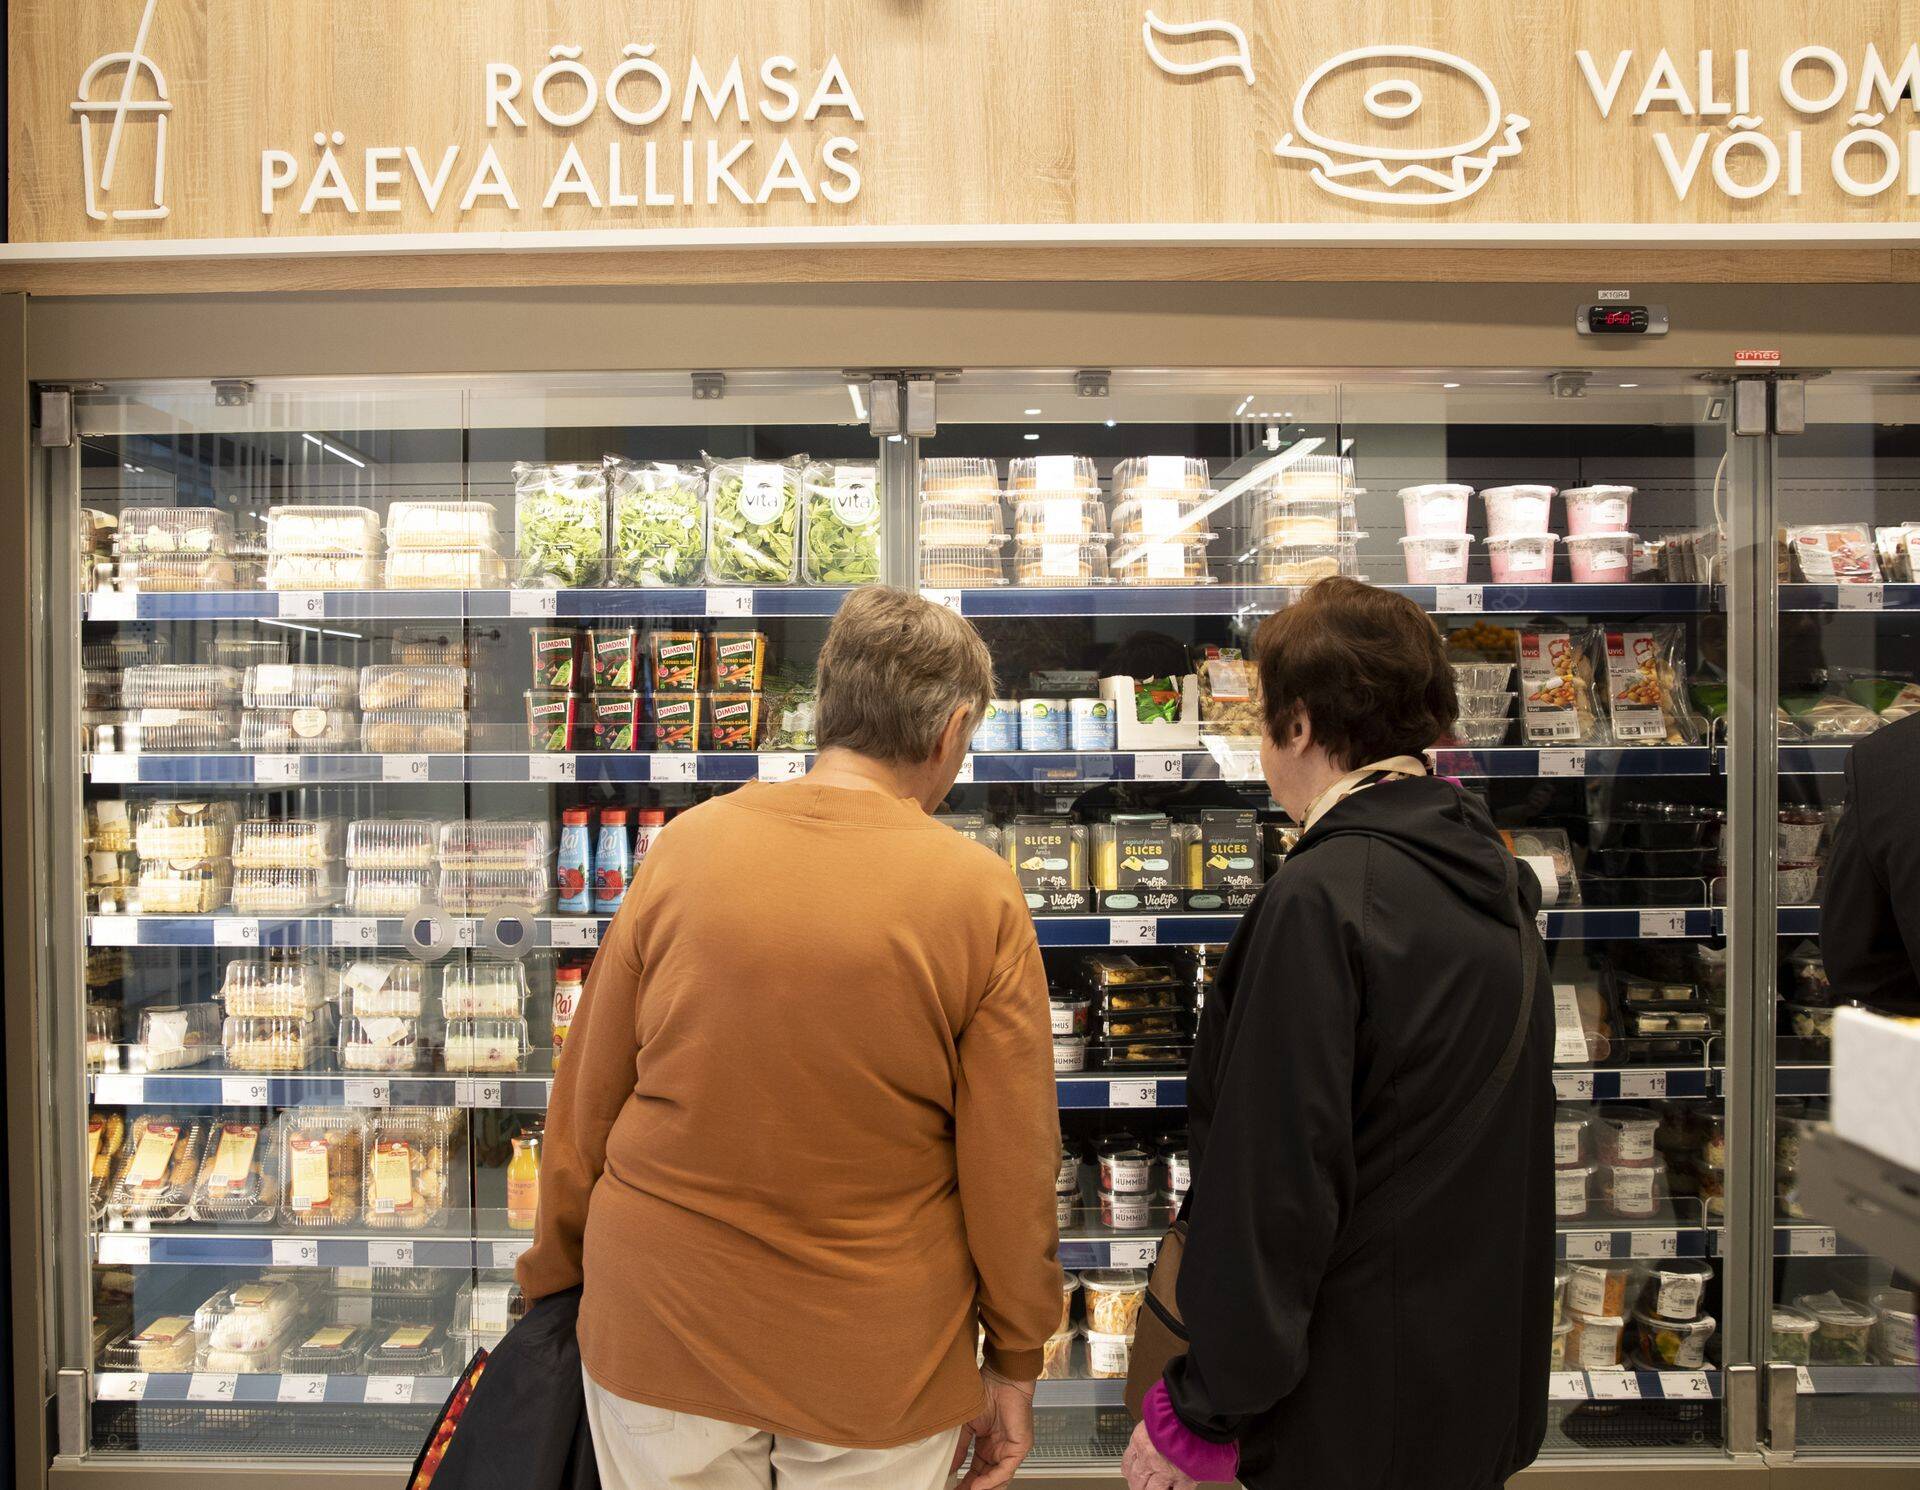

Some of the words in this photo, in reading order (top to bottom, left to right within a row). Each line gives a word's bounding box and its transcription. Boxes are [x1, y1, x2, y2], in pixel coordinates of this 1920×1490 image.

[485, 43, 865, 127] RÕÕMSA
[1576, 48, 1750, 119] VALI
[1652, 114, 1802, 201] VÕI
[262, 131, 519, 215] PÄEVA
[541, 136, 861, 210] ALLIKAS
[541, 640, 571, 651] DIMDINI
[599, 639, 628, 652] DIMDINI
[661, 644, 692, 657] DIMDINI
[722, 641, 752, 655] DIMDINI
[534, 703, 563, 714] DIMDINI
[601, 703, 630, 713] DIMDINI
[659, 703, 690, 717] DIMDINI
[718, 703, 748, 717] DIMDINI
[1024, 836, 1062, 845] SLICES
[1125, 846, 1162, 855] SLICES
[1211, 845, 1248, 853] SLICES
[1050, 893, 1085, 909] Violife
[1144, 893, 1178, 909] Violife
[1115, 1178, 1147, 1186] HUMMUS
